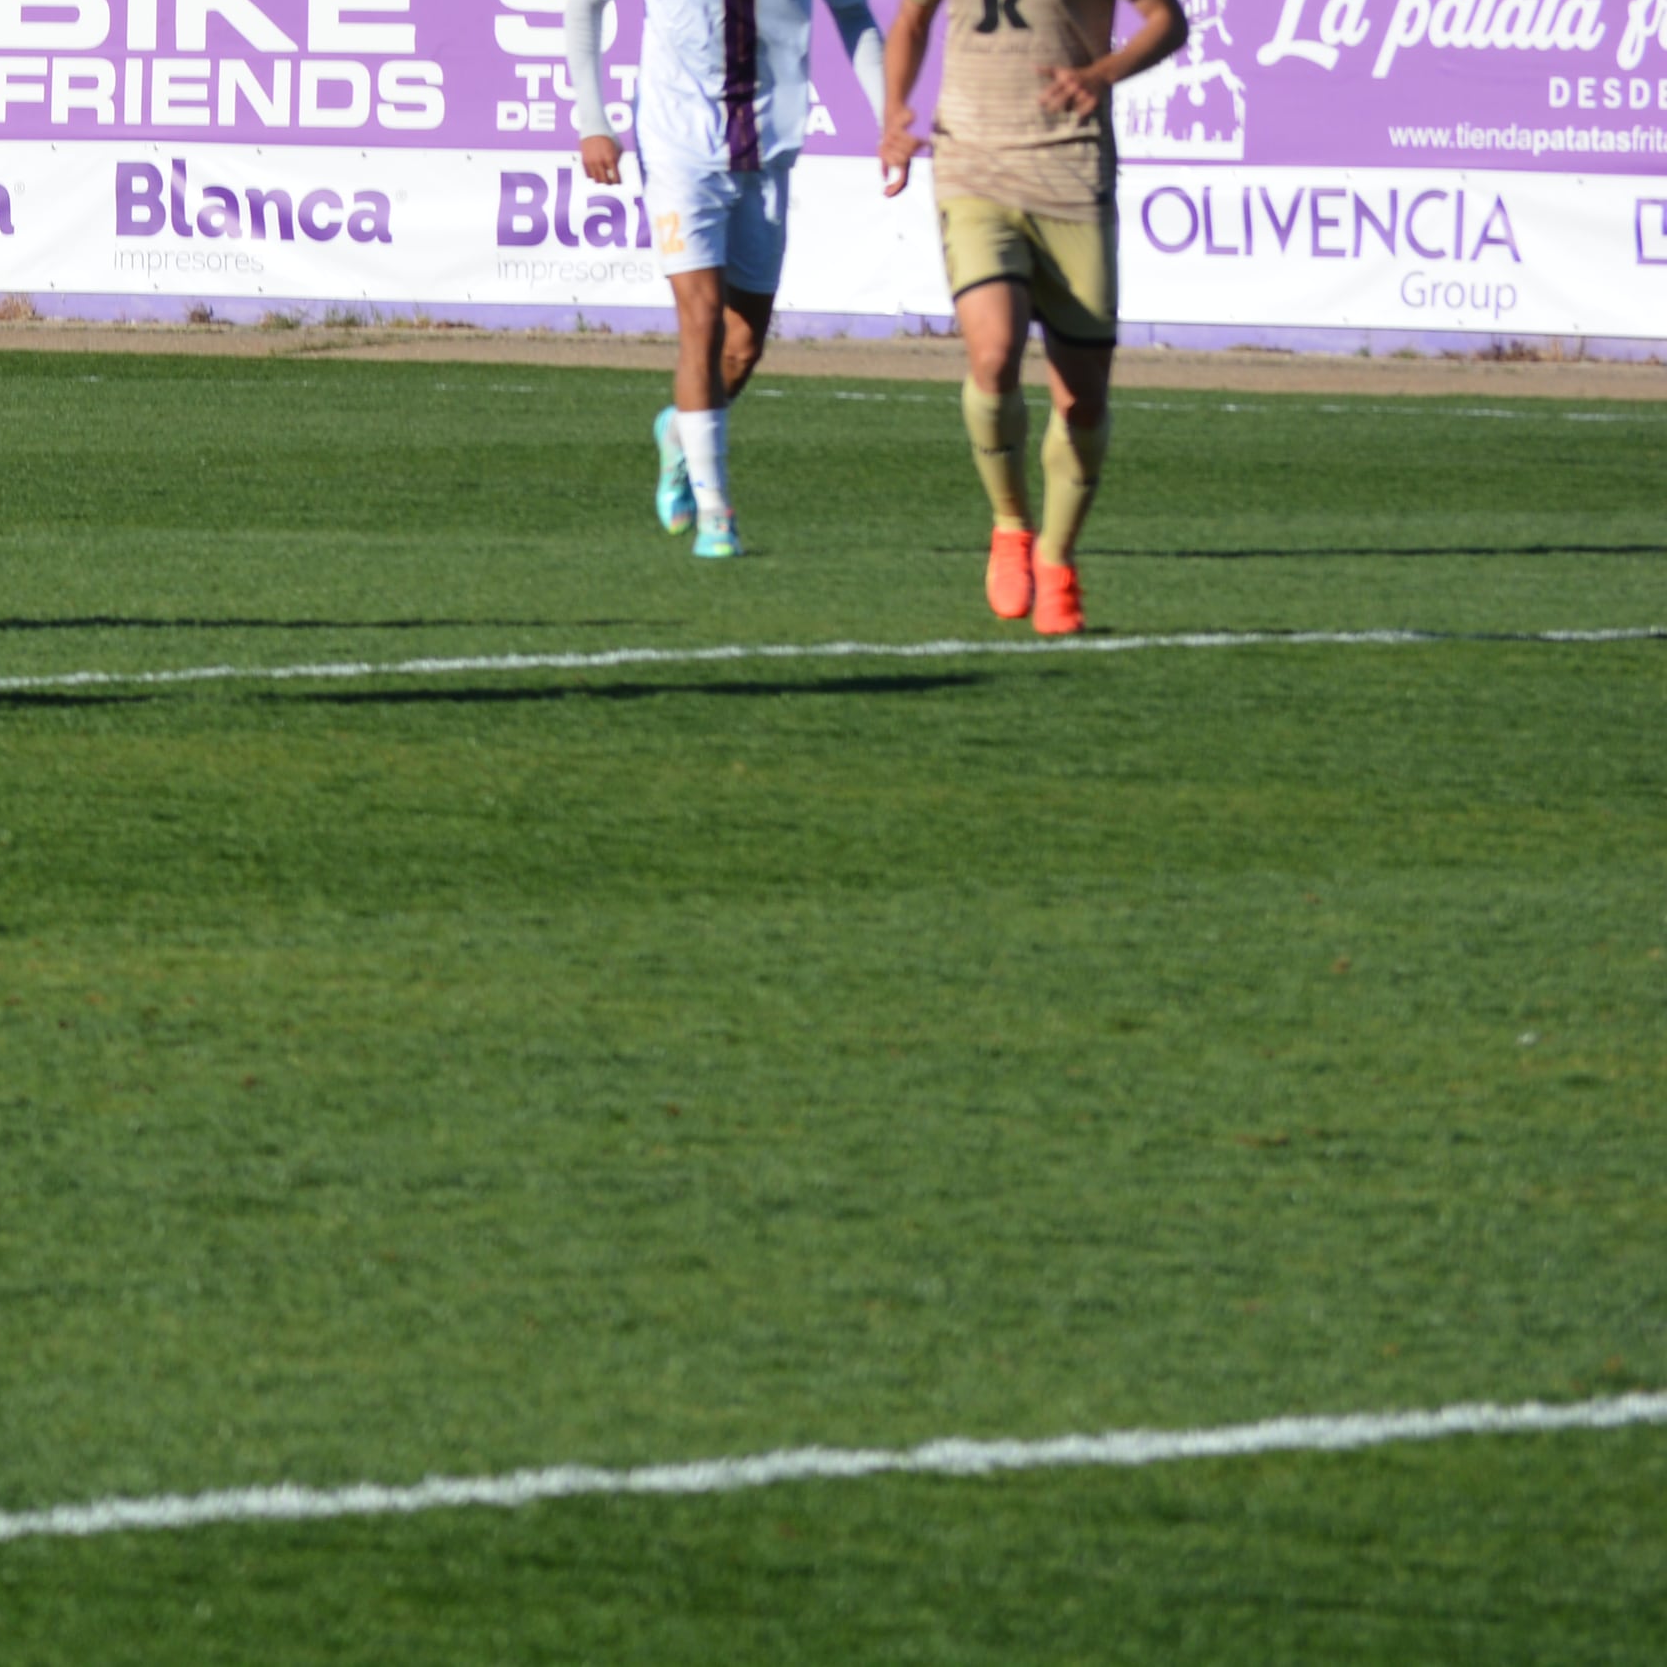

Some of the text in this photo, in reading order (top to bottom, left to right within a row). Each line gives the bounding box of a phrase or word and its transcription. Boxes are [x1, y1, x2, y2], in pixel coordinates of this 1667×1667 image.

[496, 101, 557, 133] DE
[115, 158, 394, 244] Blanca
[1140, 186, 1522, 264] OLIVENCIA
[113, 246, 266, 275] impresores
[1400, 270, 1518, 320] Group
